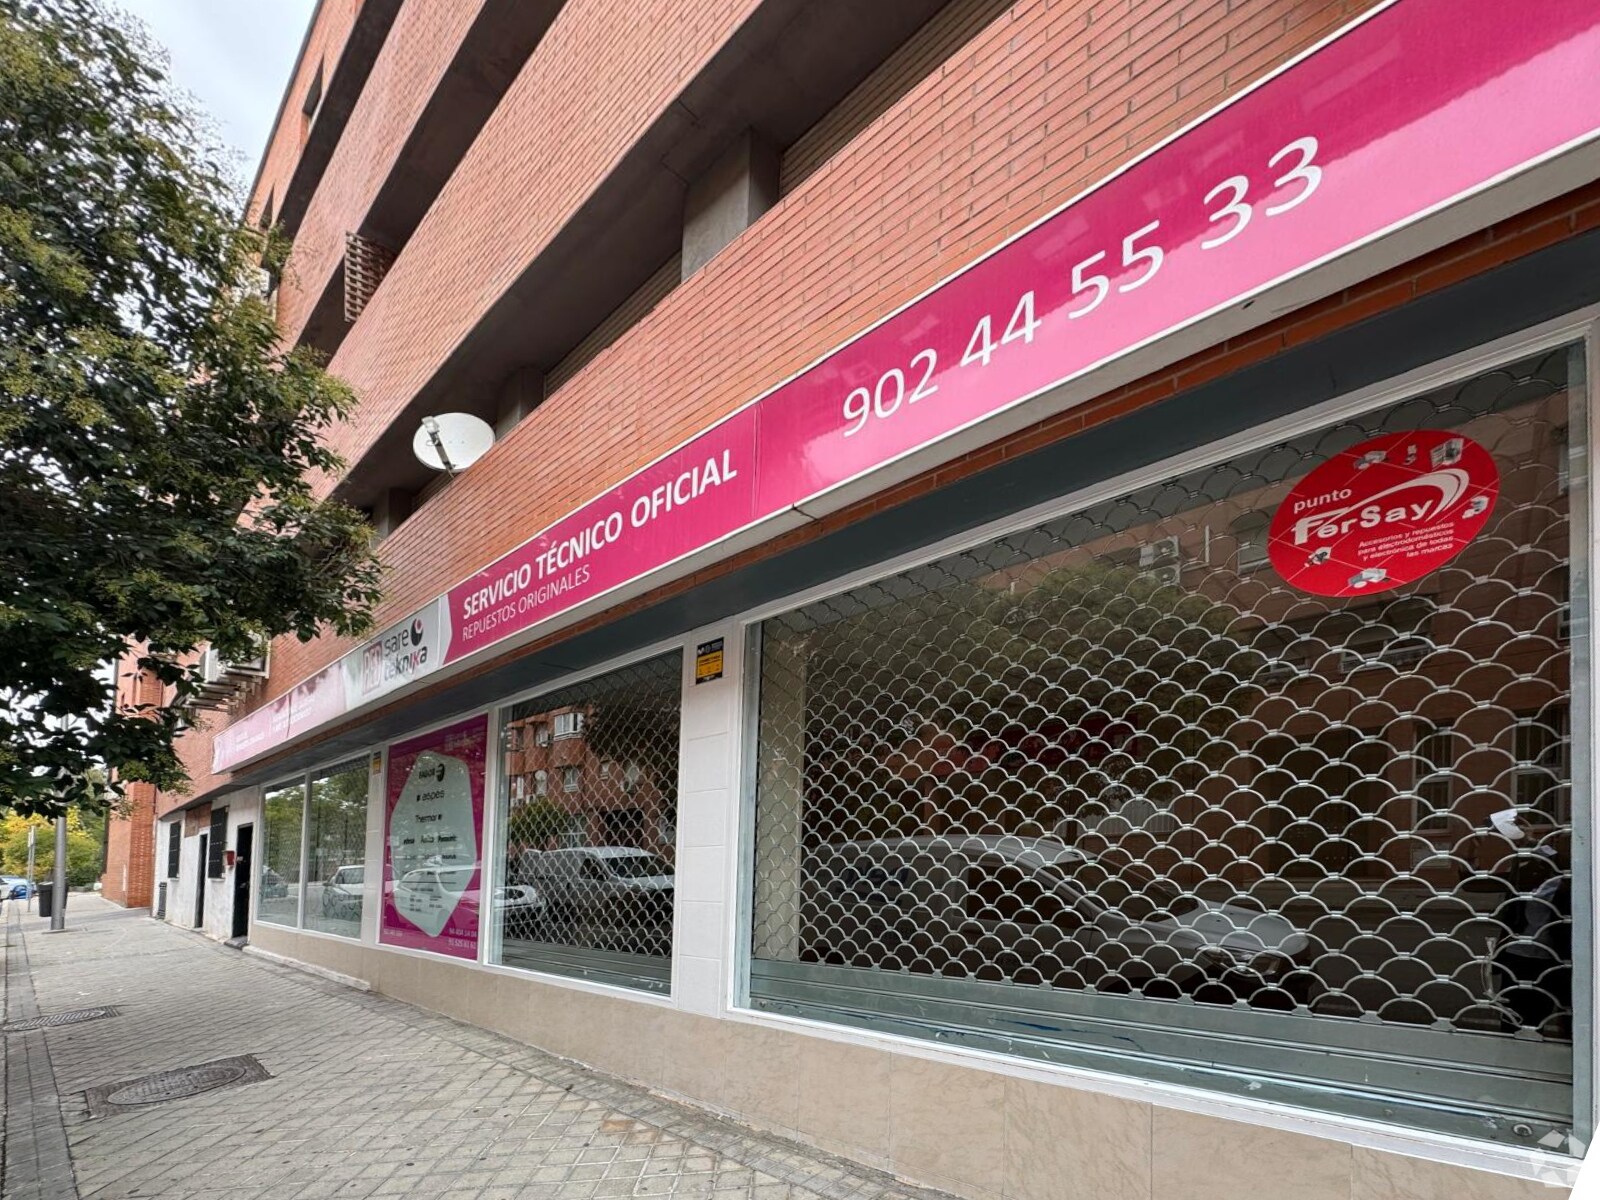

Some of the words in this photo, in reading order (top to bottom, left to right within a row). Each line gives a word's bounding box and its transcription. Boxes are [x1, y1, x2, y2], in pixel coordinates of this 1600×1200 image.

[843, 348, 939, 437] 902
[960, 290, 1042, 367] 44
[1069, 219, 1164, 319] 55
[1201, 136, 1322, 250] 33
[1294, 488, 1352, 514] punto
[463, 563, 531, 619] SERVICIO
[536, 512, 623, 579] TÉCNICO
[630, 449, 738, 528] OFICIAL
[1291, 500, 1434, 545] FerSay
[1412, 522, 1455, 535] repuestos
[1421, 543, 1454, 554] marcas
[462, 601, 516, 641] REPUESTOS
[518, 564, 591, 613] ORIGINALES
[385, 629, 409, 657] sare
